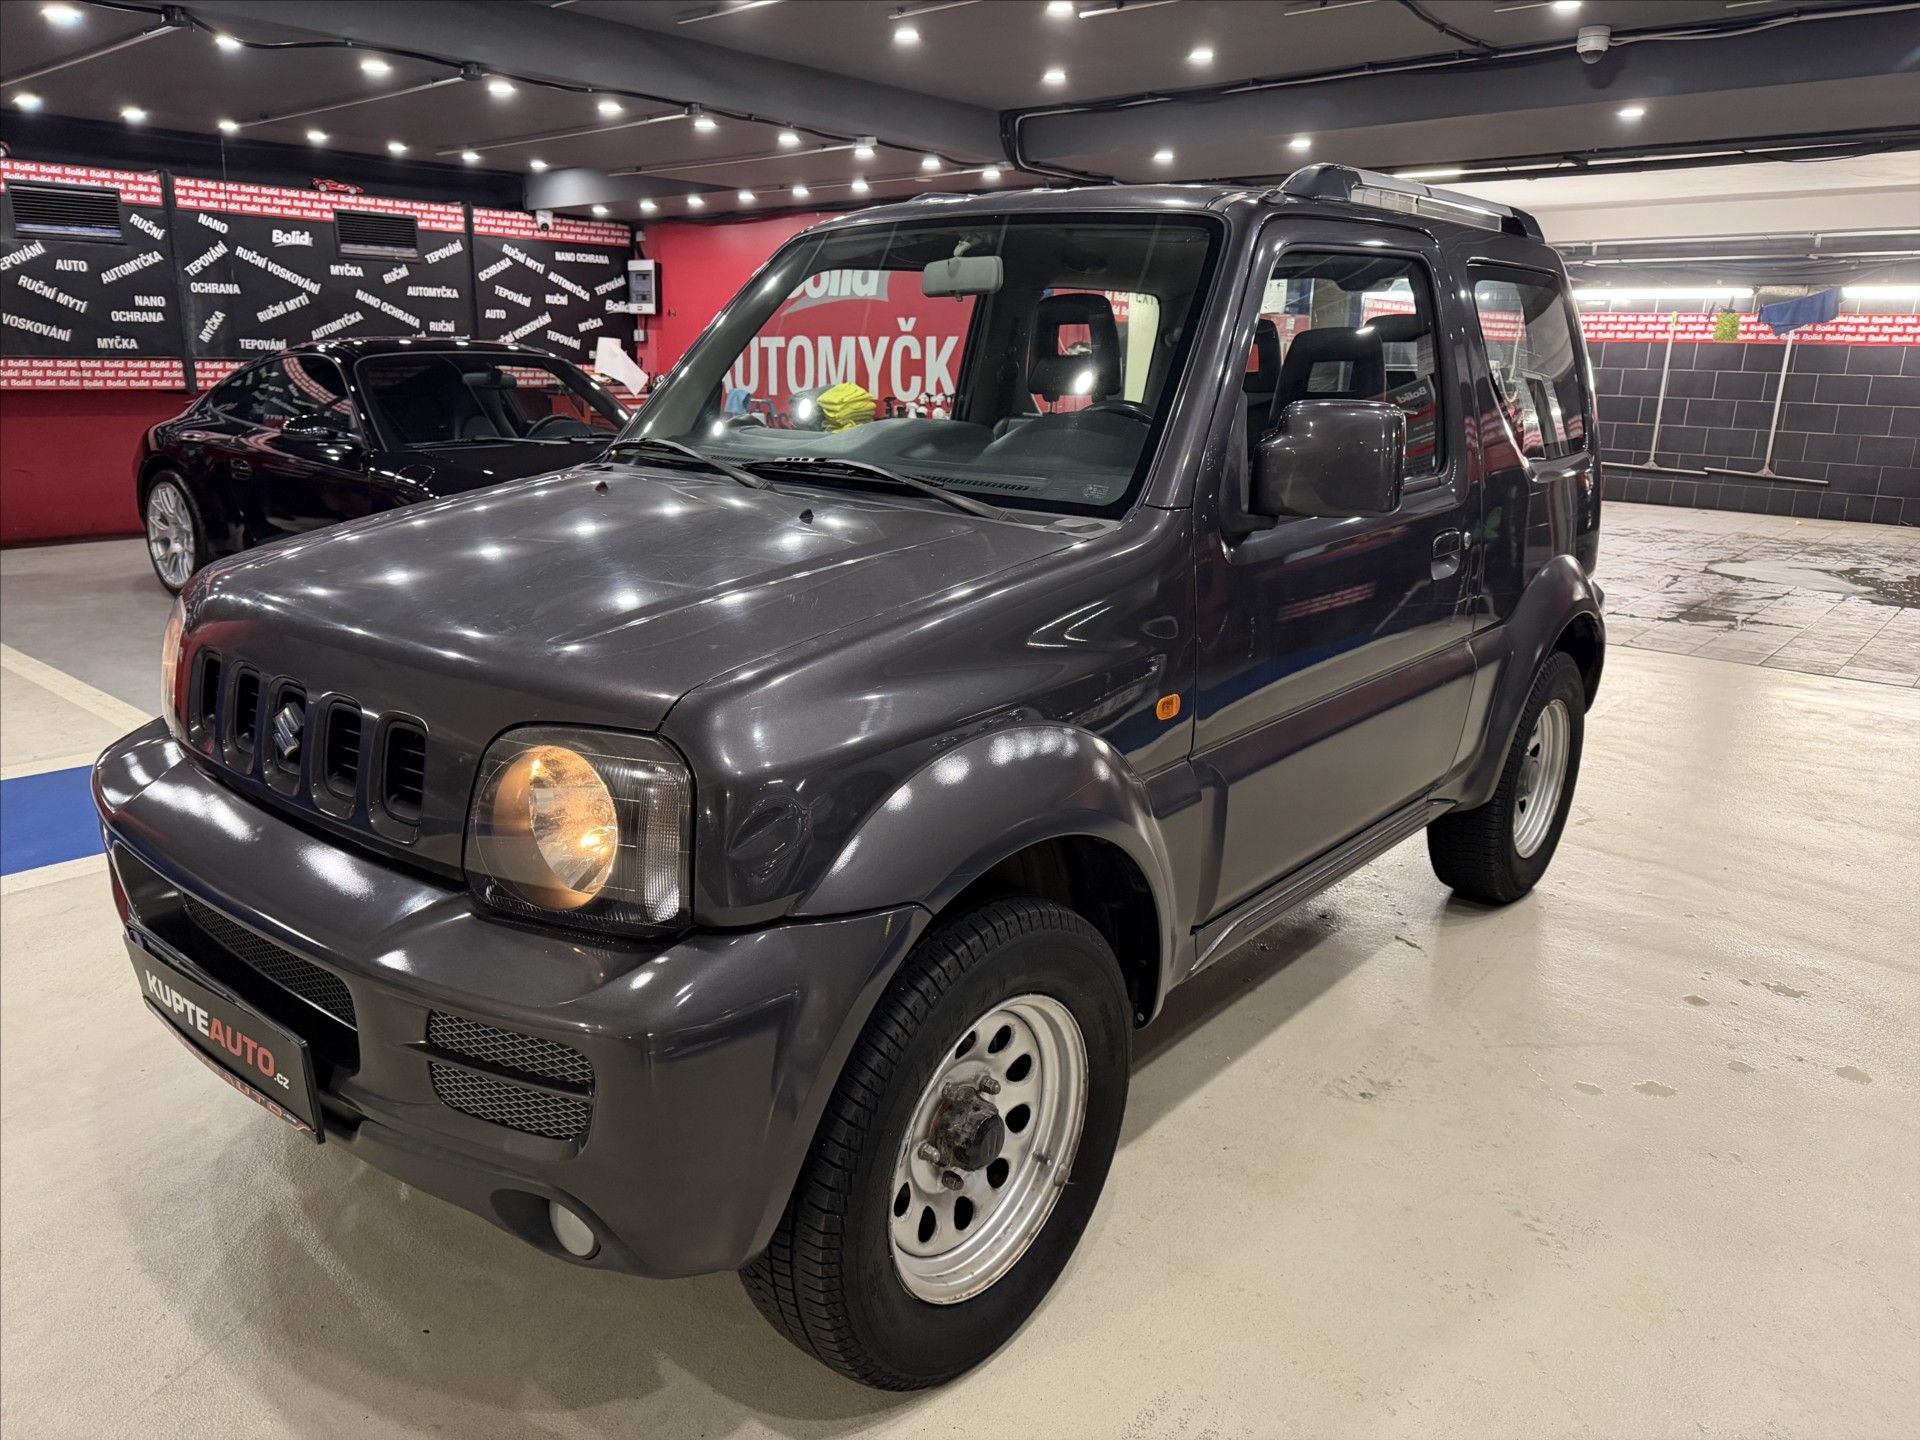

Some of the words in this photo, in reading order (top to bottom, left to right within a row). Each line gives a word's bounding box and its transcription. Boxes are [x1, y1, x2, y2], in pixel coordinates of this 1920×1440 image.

[129, 213, 166, 241] RUČNÍ
[197, 213, 229, 234] NANO
[272, 229, 311, 246] Bolid
[184, 240, 229, 277] TEPOVÁNÍ
[425, 239, 464, 264] TEPOVÁNÍ
[502, 243, 527, 264] RUČNÍ
[525, 257, 546, 275] MYTÍ
[555, 251, 575, 262] NANO
[576, 252, 610, 265] OCHRANA
[55, 259, 88, 272] AUTO
[100, 250, 164, 284] AUTOMYČKA
[235, 246, 268, 269] RUČNÍ
[267, 261, 321, 295] VOSKOVÁNÍ
[330, 263, 364, 277] MYČKA
[382, 264, 410, 285] RUČNÍ
[478, 257, 514, 282] OCHRANA
[17, 274, 58, 300] RUČNÍ
[56, 292, 88, 313] MYTÍ
[190, 281, 241, 294] OCHRANA
[407, 285, 459, 299] AUTOMYČKA
[548, 271, 590, 301] AUTOMYČKA
[594, 274, 626, 296] TEPOVÁNÍ
[134, 295, 166, 307] NANO
[256, 301, 287, 323] RUČNÍ
[285, 292, 310, 313] MYTÍ
[494, 285, 532, 308] TEPOVÁNÍ
[545, 293, 569, 306] RUČNÍ
[111, 310, 165, 323] OCHRANA
[355, 289, 381, 309] NANO
[381, 302, 420, 329] OCHRANA
[485, 309, 507, 320] AUTO
[2, 312, 72, 342] VOSKOVÁNÍ
[198, 310, 226, 344] MYČKA
[311, 310, 364, 340] AUTOMYČKA
[429, 319, 455, 333] RUČNÍ
[97, 335, 139, 350] MYČKA
[239, 338, 287, 351] TEPOVÁNÍ
[546, 330, 582, 350] TEPOVÁNÍ
[145, 969, 290, 1090] KUPTEAUTO.cz
